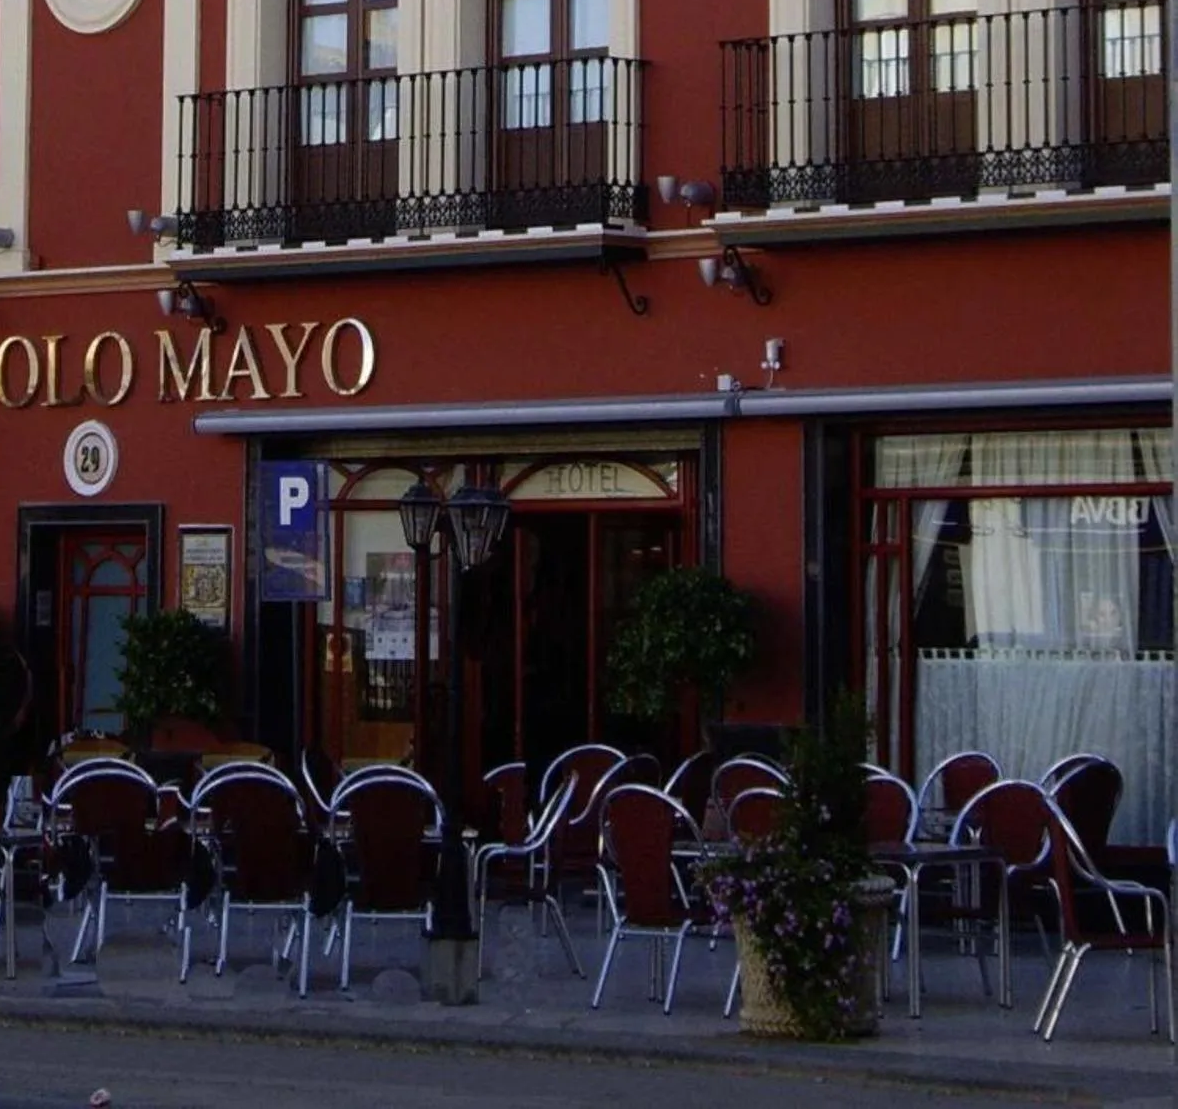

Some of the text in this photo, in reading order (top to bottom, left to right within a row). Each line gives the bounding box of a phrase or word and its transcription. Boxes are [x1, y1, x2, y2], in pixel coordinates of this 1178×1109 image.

[154, 317, 375, 401] MAYO
[81, 445, 100, 473] 29
[543, 461, 626, 493] HOTEL
[279, 476, 309, 525] P
